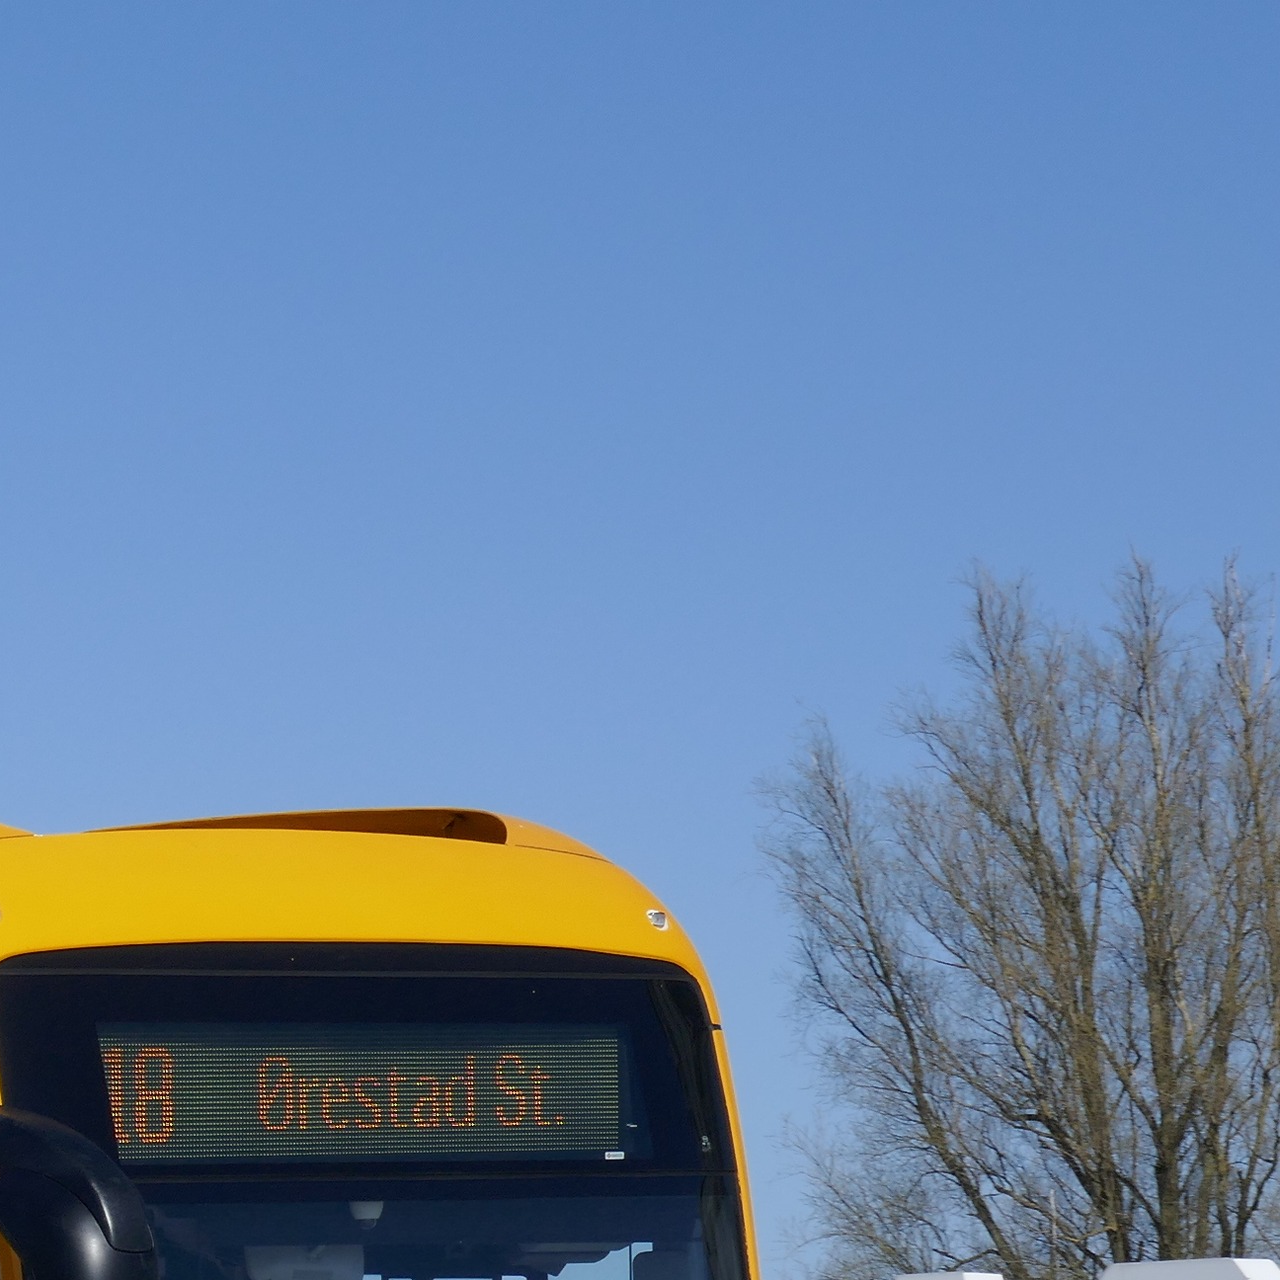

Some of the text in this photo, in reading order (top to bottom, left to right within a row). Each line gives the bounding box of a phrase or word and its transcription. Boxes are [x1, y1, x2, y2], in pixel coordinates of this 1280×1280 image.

[100, 1046, 565, 1145] 18 Ørestad St.
